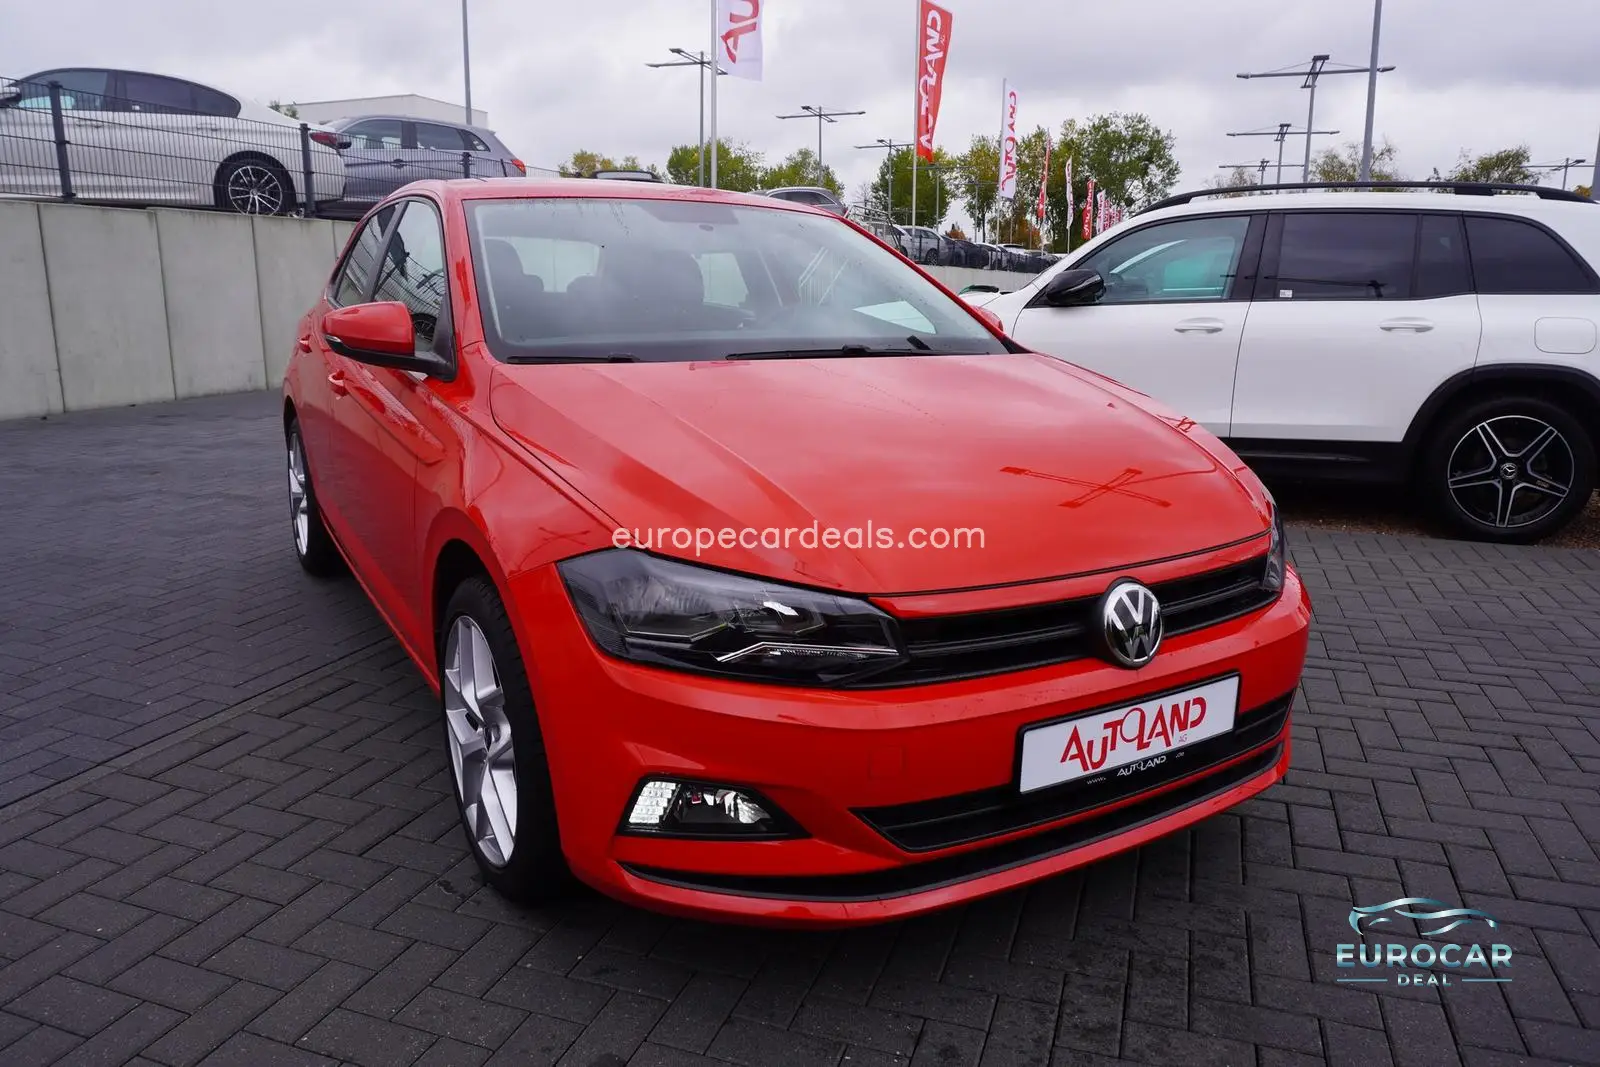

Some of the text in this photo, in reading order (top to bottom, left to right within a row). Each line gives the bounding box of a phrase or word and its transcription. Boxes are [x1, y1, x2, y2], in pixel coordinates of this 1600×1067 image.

[1001, 90, 1017, 191] AUTOAND
[1105, 583, 1162, 663] VW
[1060, 697, 1207, 772] AUTOLAND
